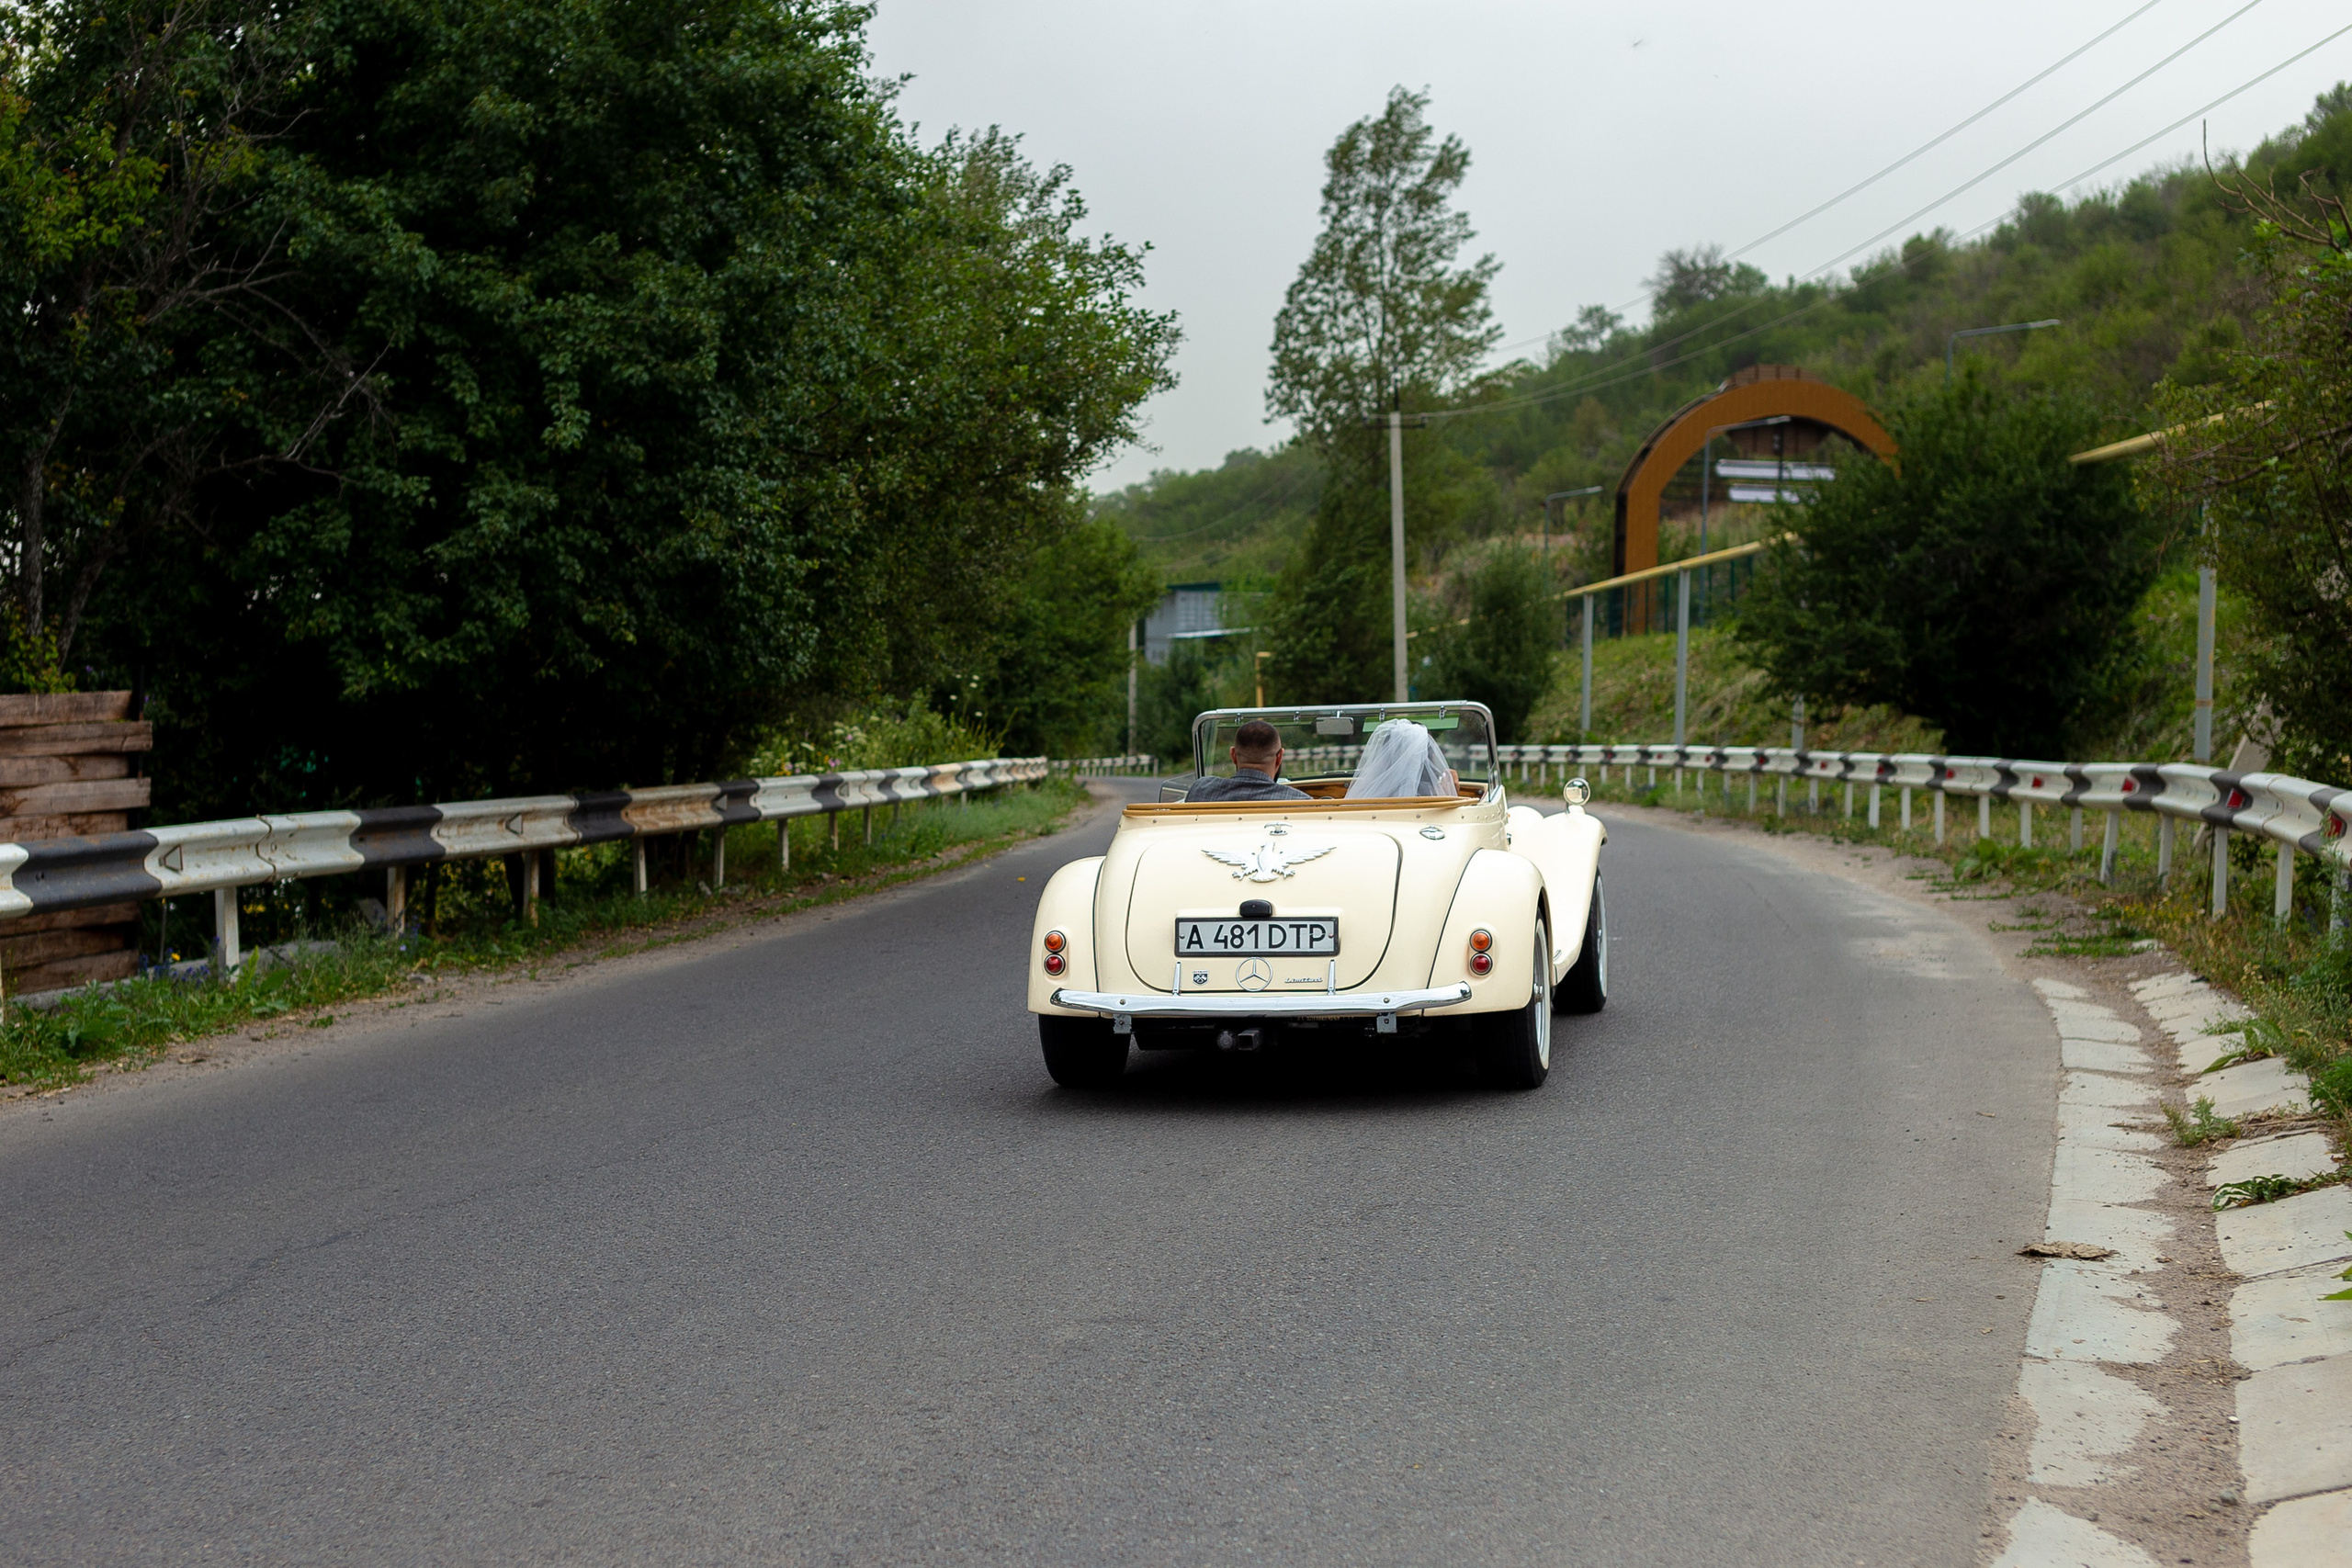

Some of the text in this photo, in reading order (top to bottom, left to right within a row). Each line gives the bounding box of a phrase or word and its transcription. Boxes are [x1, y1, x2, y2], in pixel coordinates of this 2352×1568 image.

[1186, 924, 1326, 949] A 481 DTP
